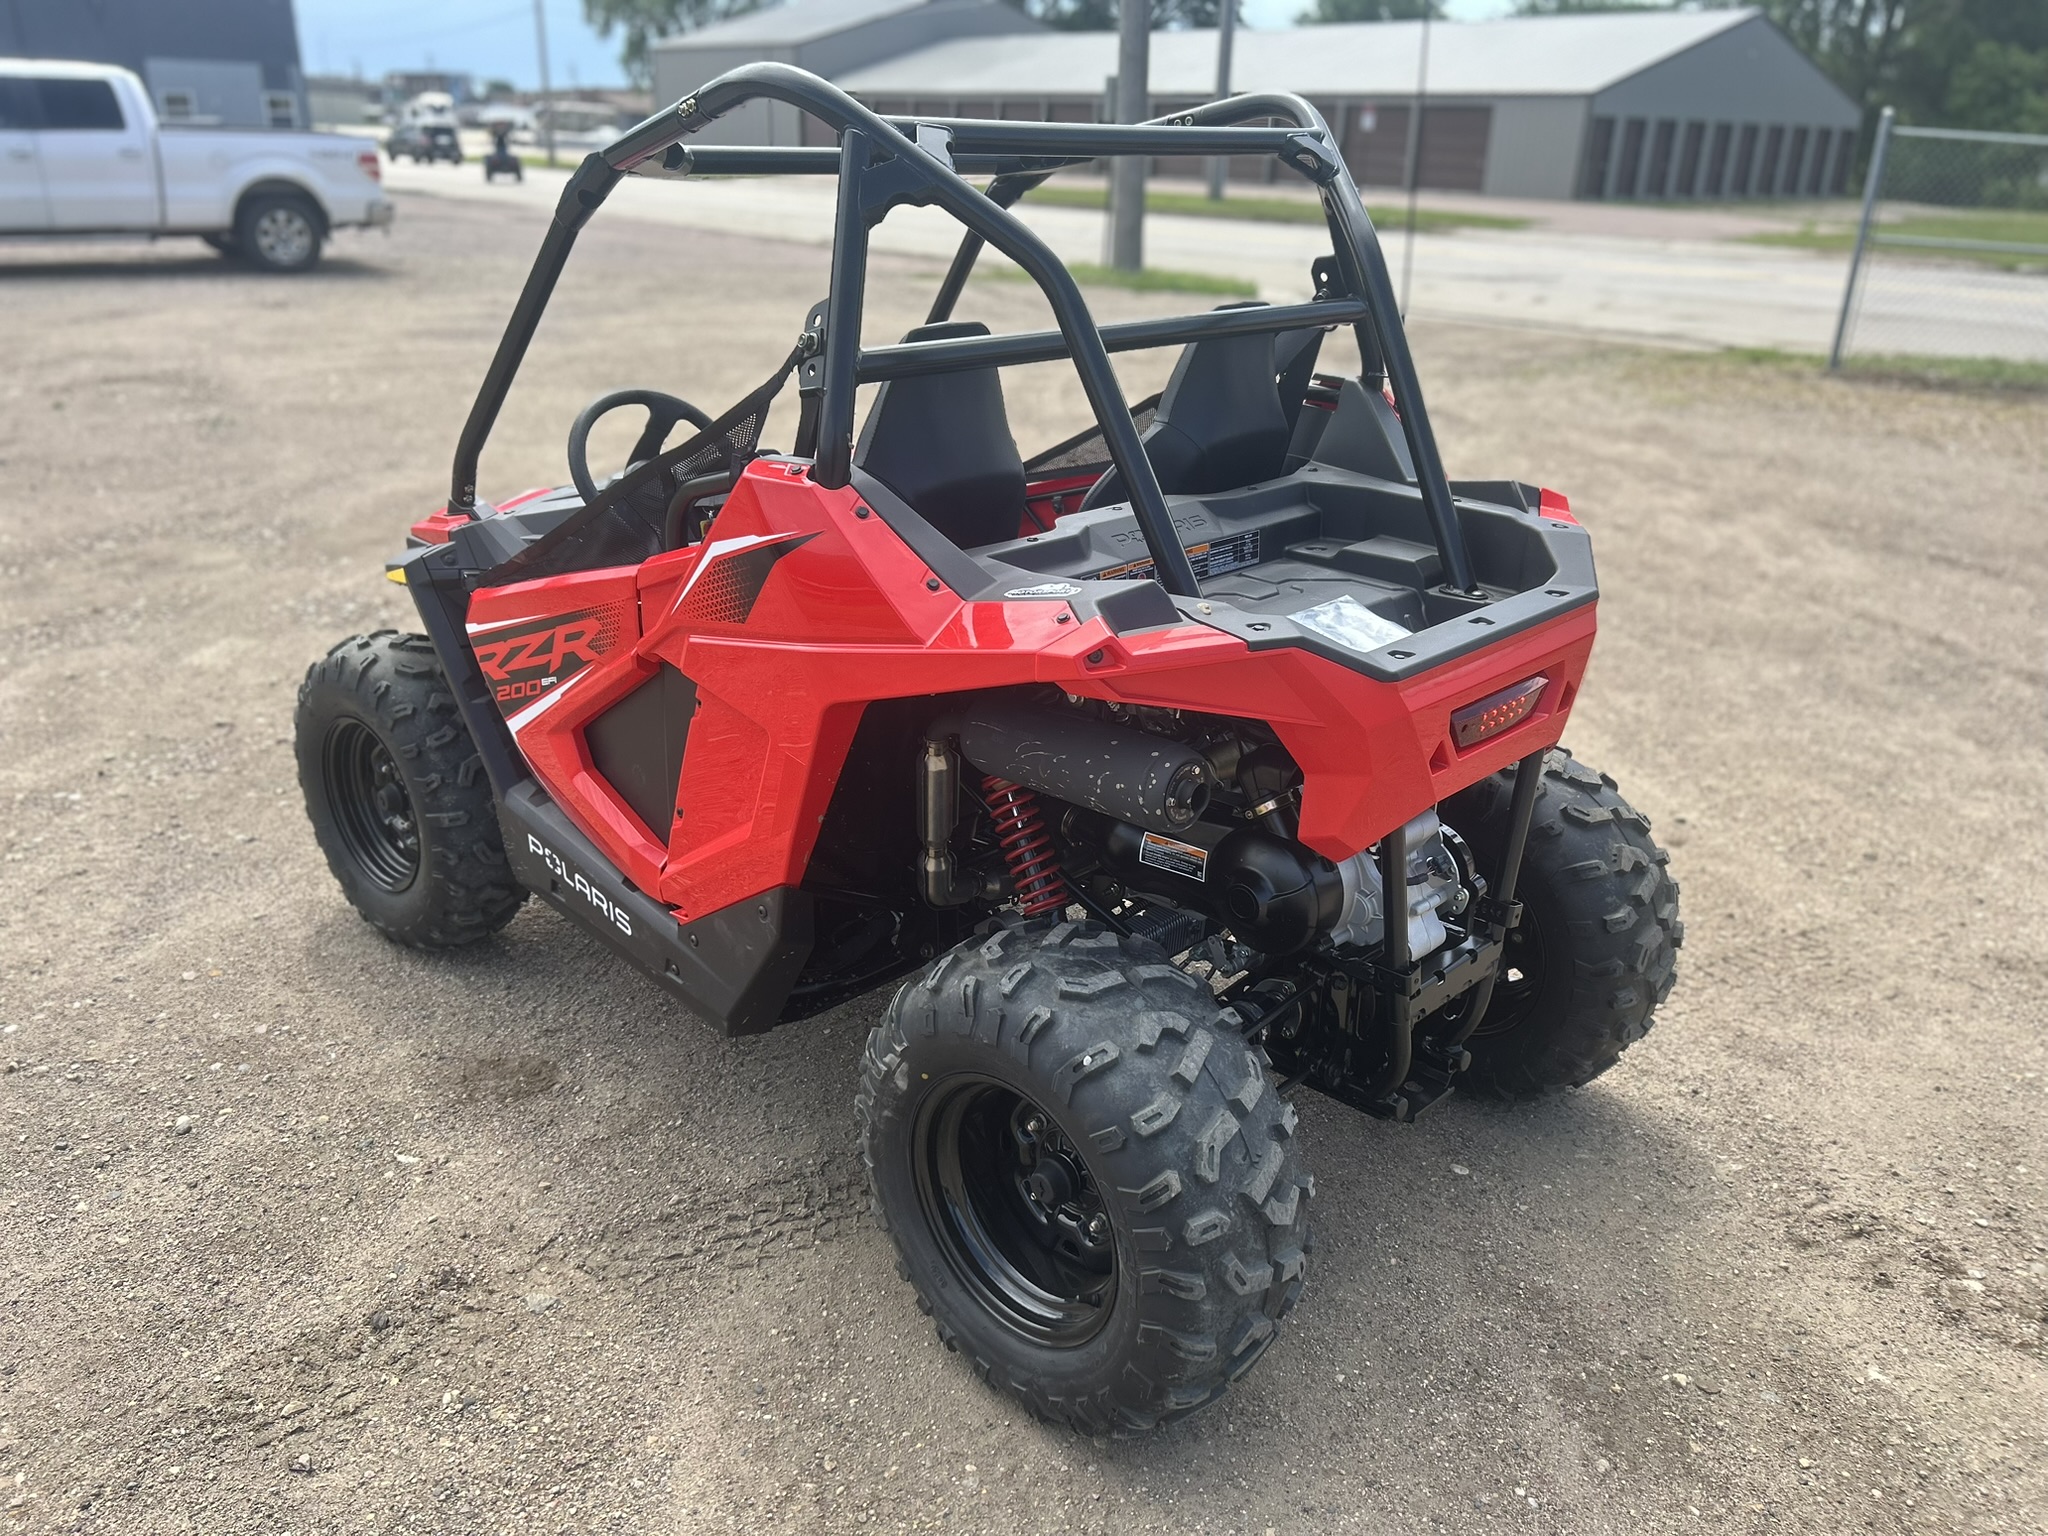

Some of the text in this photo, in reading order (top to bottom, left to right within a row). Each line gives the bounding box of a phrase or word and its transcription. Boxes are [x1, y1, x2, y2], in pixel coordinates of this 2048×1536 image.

[1111, 514, 1208, 548] PORIS
[473, 617, 601, 681] RZR
[496, 679, 541, 701] 200
[527, 833, 633, 937] POLARIS
